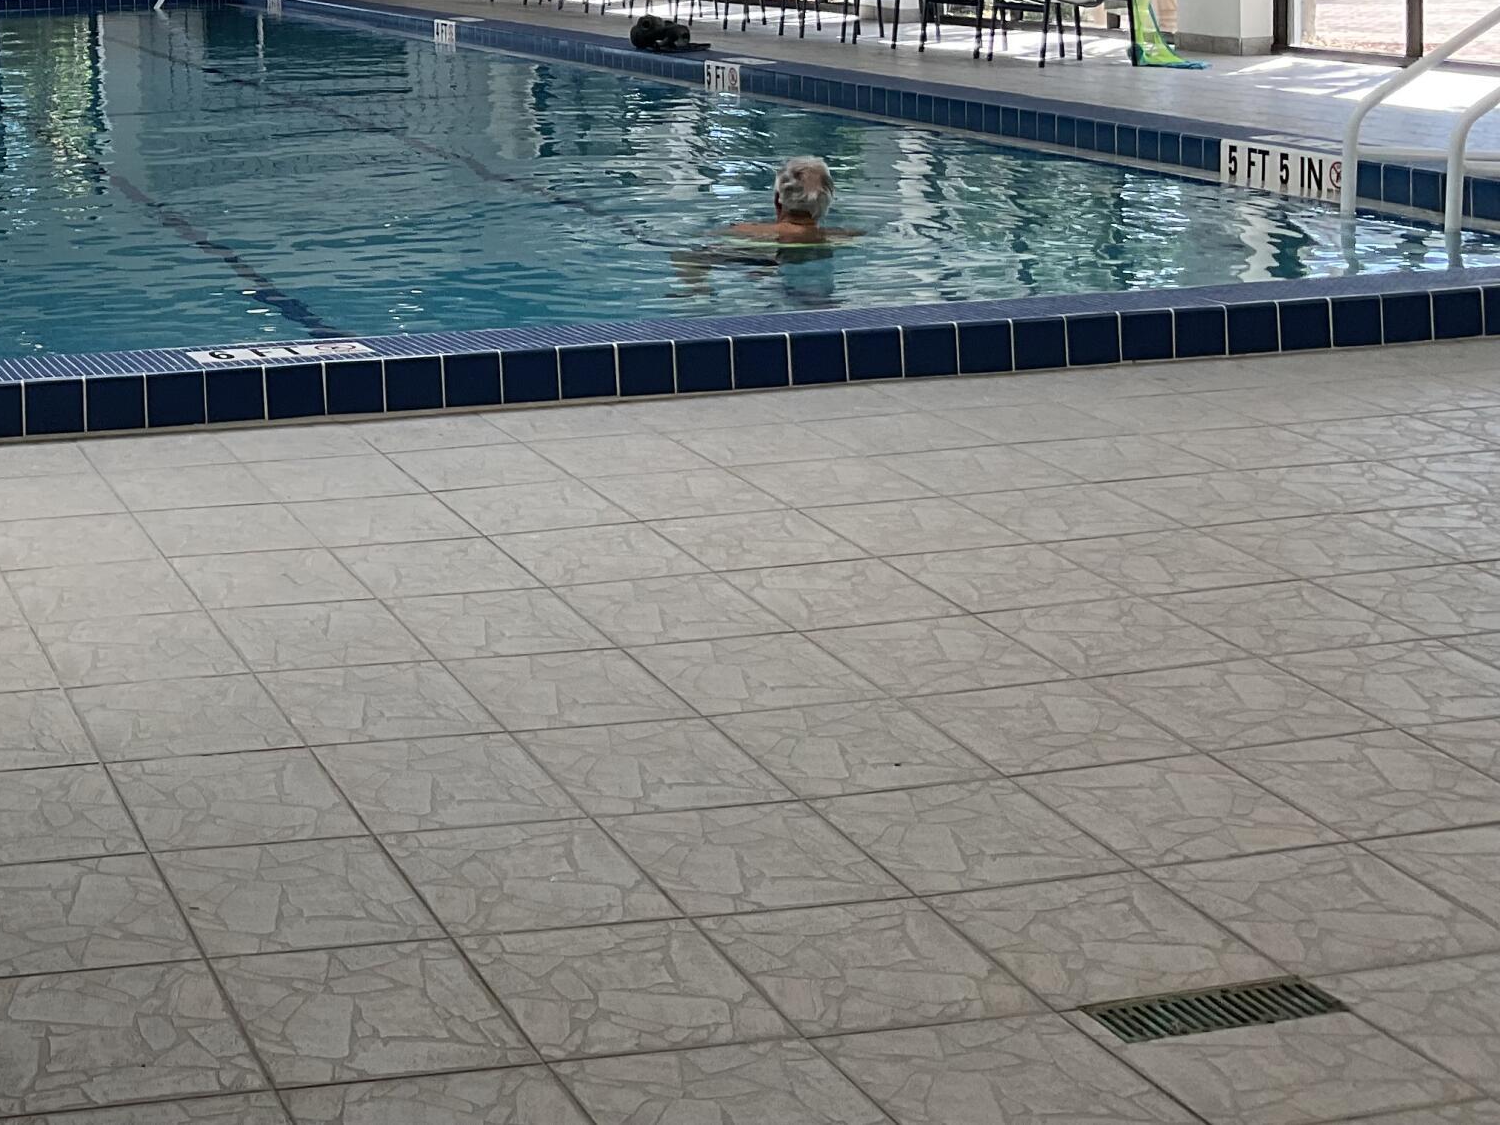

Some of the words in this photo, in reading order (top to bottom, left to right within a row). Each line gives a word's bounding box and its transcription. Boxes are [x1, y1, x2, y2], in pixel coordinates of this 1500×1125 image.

[706, 64, 711, 87] 5
[715, 65, 725, 90] FT
[1228, 144, 1237, 176] 5
[1247, 147, 1269, 181] FT
[1279, 152, 1289, 184] 5
[1300, 156, 1323, 191] IN
[208, 350, 235, 360] 6
